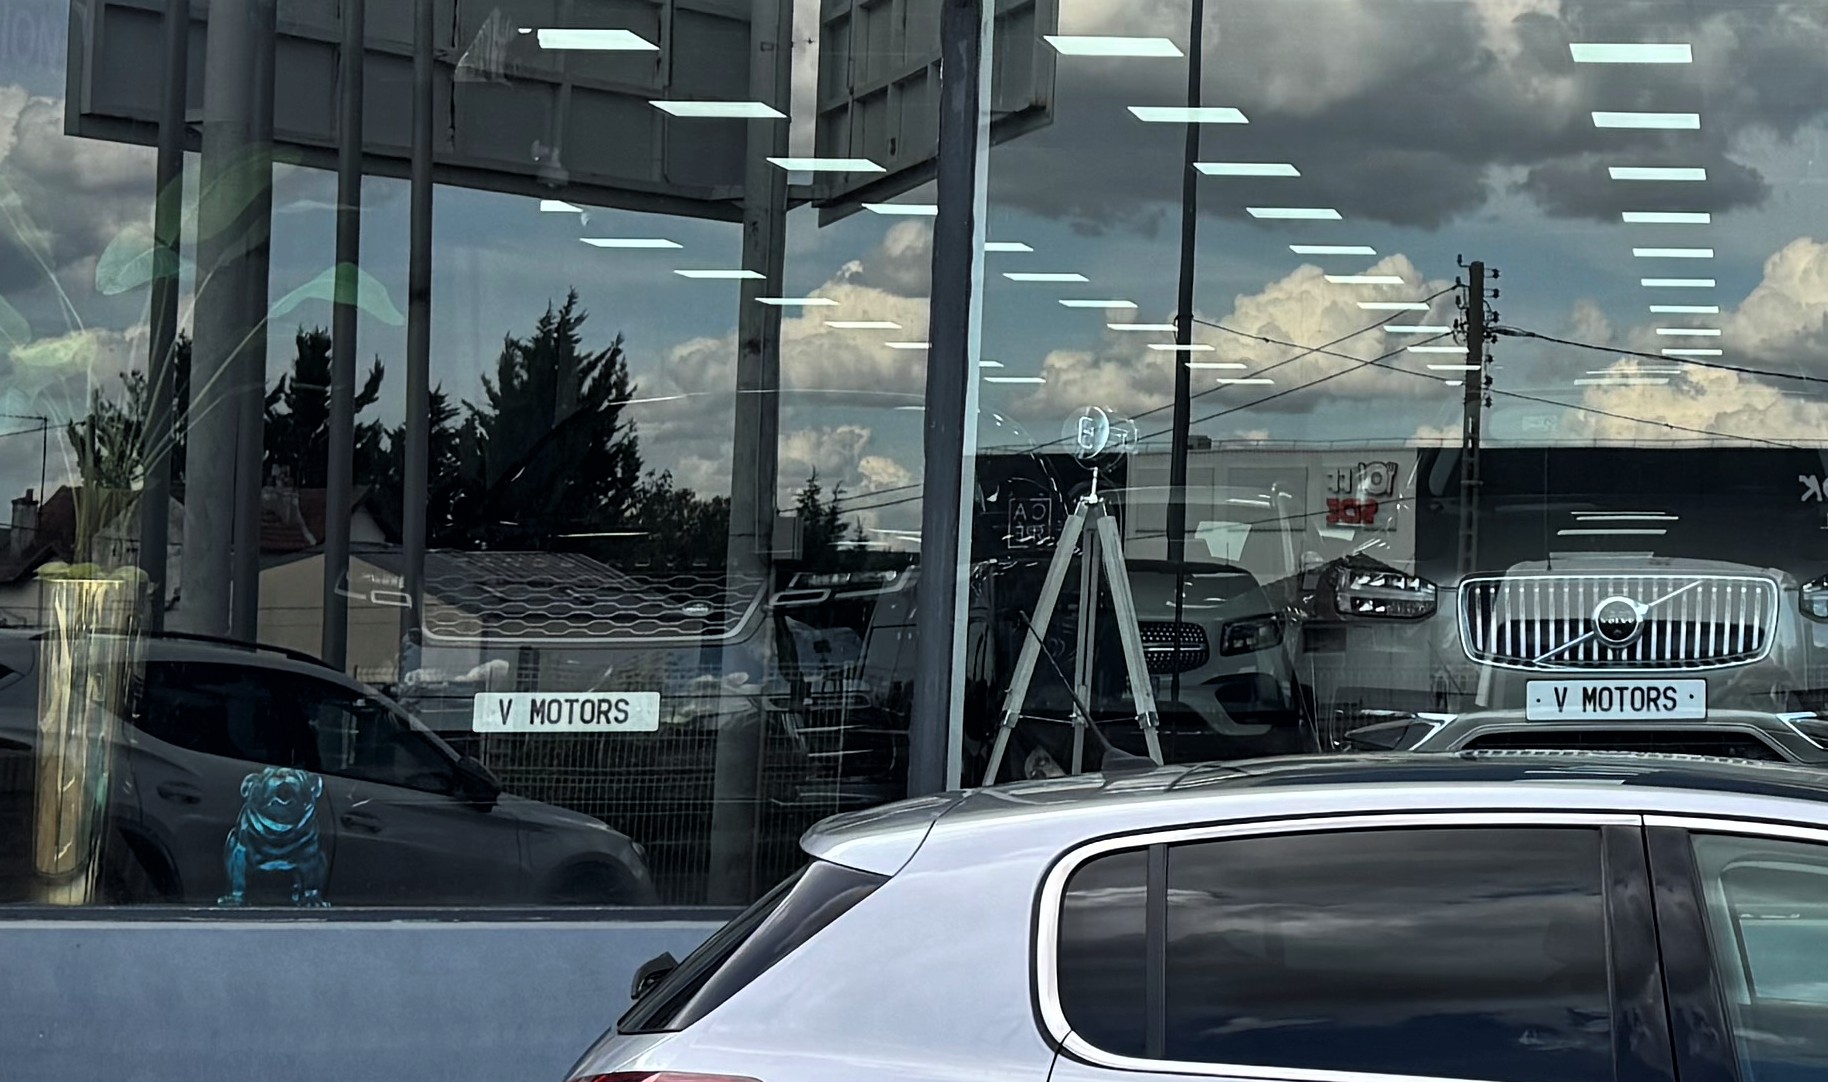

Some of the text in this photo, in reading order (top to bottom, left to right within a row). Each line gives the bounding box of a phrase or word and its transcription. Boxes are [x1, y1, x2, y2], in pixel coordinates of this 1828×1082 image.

[500, 698, 629, 725] V MOTORS
[1554, 686, 1678, 712] V MOTORS
